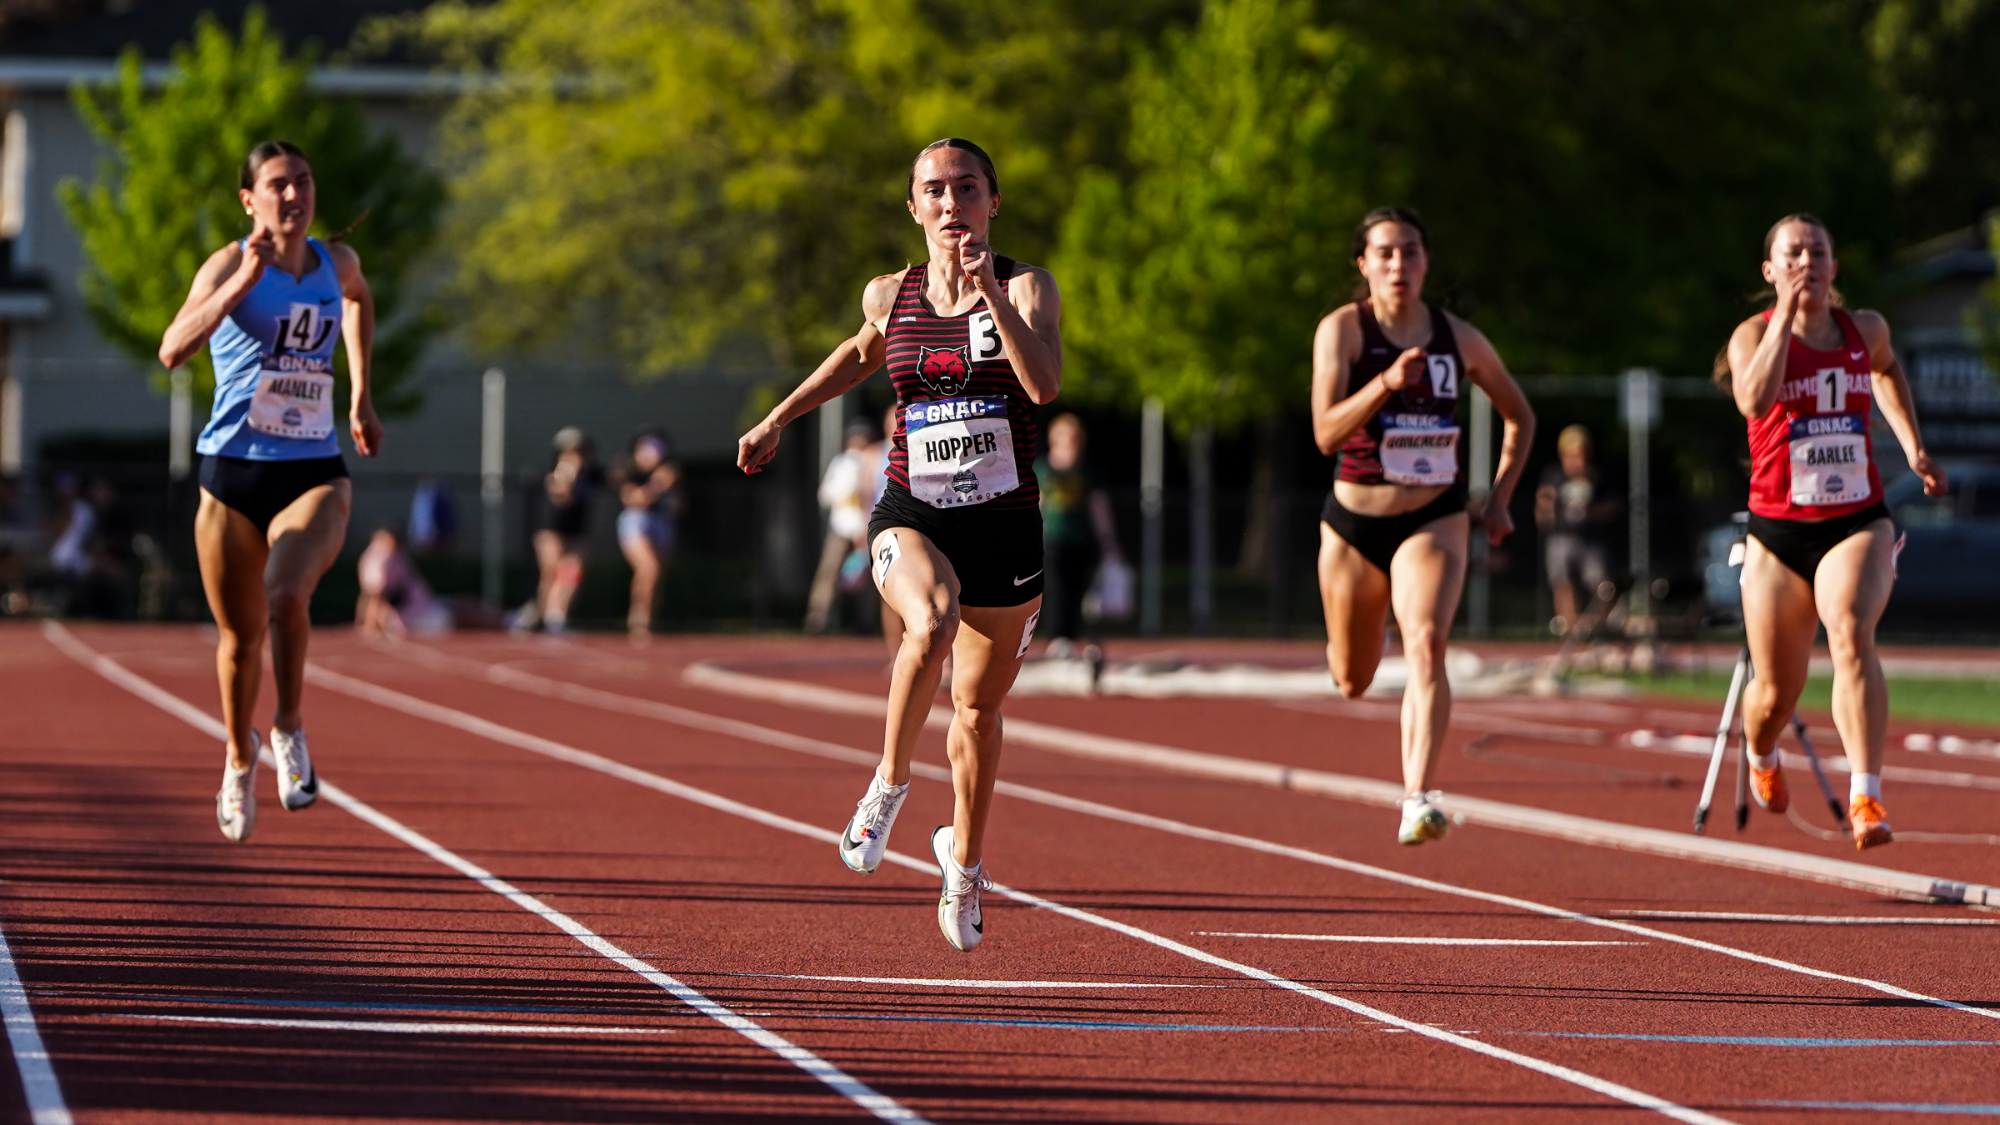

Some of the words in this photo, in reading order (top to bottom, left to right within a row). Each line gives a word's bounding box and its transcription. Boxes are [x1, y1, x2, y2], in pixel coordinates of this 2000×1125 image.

[292, 308, 311, 347] 4
[979, 315, 1002, 357] 3
[267, 379, 322, 400] MANLEY
[1434, 359, 1452, 394] 2
[1825, 370, 1837, 409] 1
[926, 399, 987, 423] GNAC
[1395, 413, 1441, 429] GNAC
[1807, 416, 1852, 435] GNAC
[925, 431, 997, 463] HOPPER
[1806, 445, 1856, 465] BARLEE
